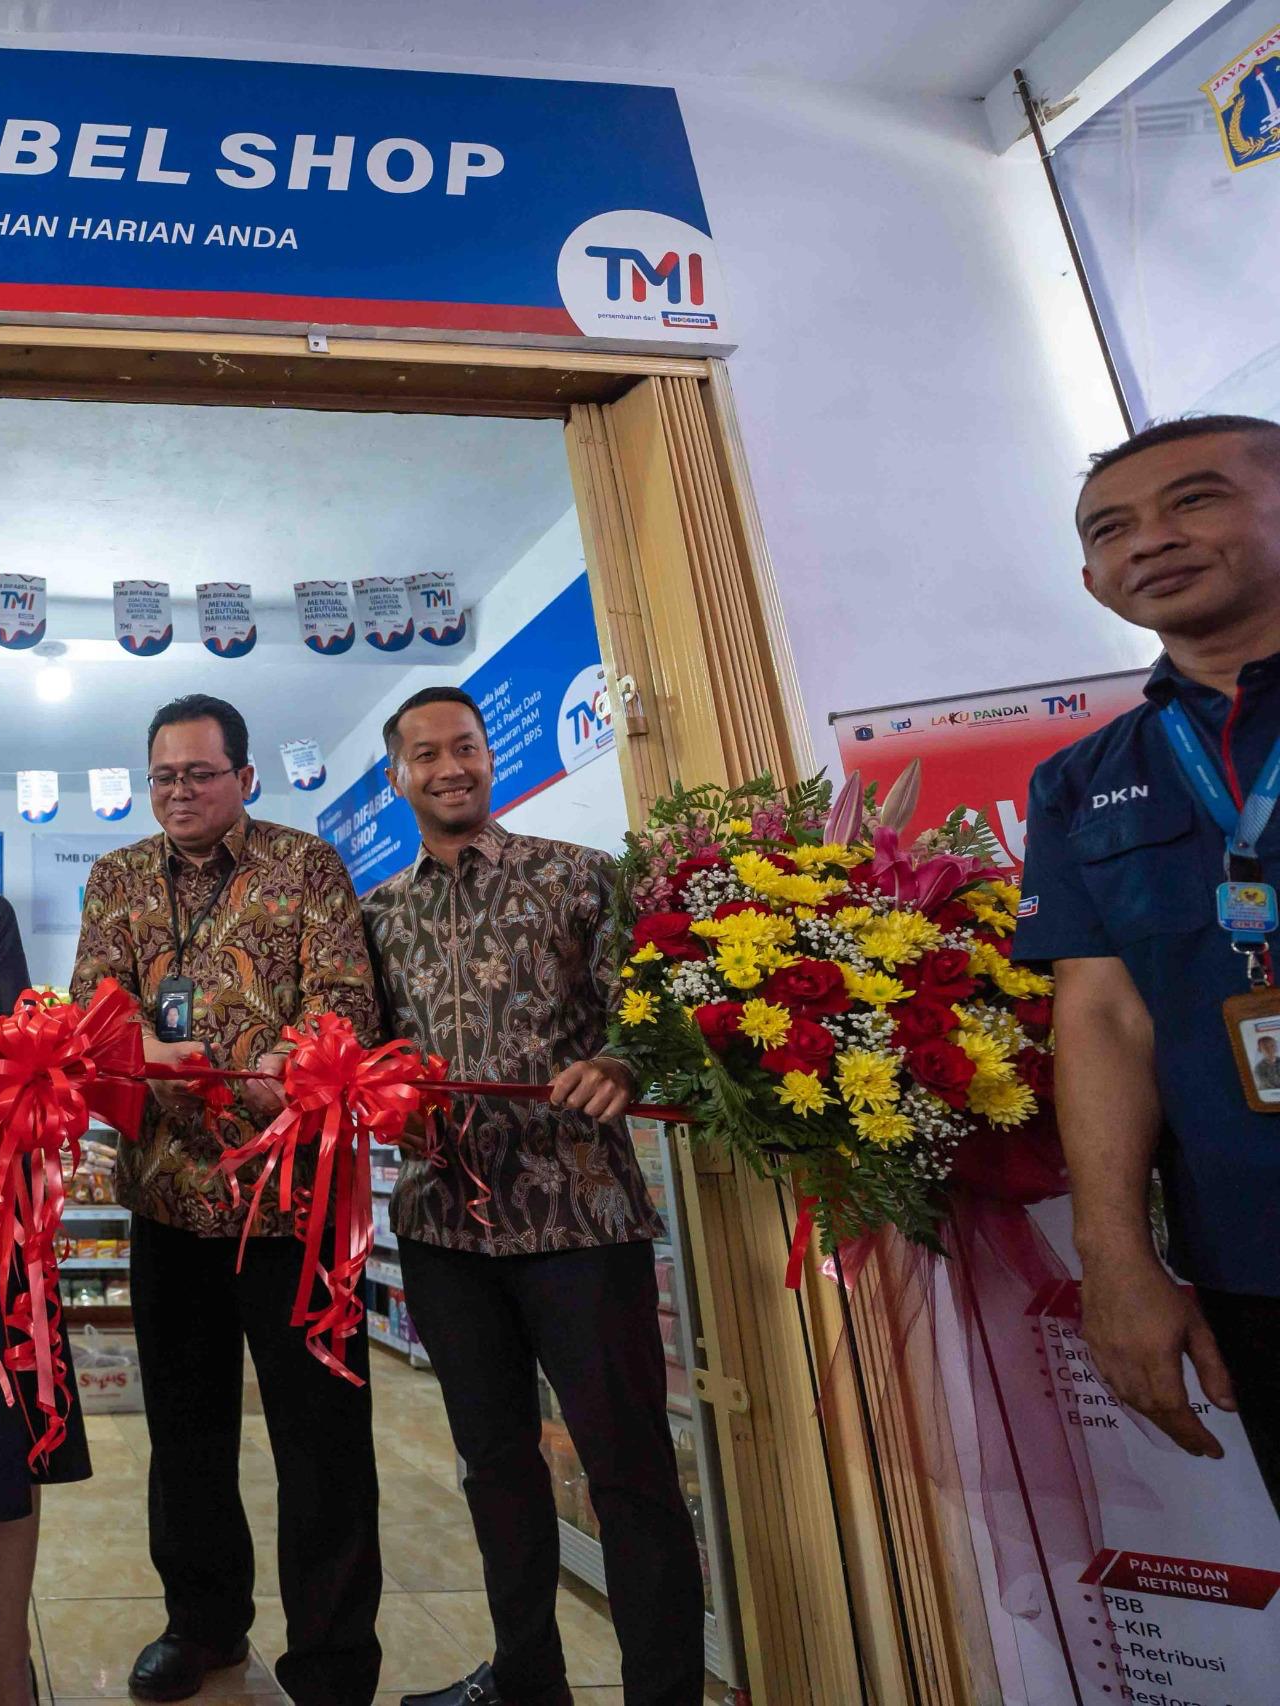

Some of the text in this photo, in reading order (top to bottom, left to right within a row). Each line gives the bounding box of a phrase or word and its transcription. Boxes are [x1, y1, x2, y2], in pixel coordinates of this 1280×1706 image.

[1213, 29, 1280, 92] JAYA RAY
[214, 130, 506, 197] SHOP
[67, 216, 197, 245] HARIAN
[203, 224, 300, 251] ANDA
[584, 245, 705, 306] TMI
[597, 312, 642, 321] persembahan
[0, 591, 35, 611] TMI
[208, 600, 245, 608] MENJUAL
[305, 605, 348, 613] KEBUTUHAN
[420, 588, 452, 608] TMI
[204, 607, 250, 615] KEBUTUHAN
[494, 680, 509, 701] juga
[496, 694, 511, 713] PLN
[496, 718, 503, 730] &
[503, 703, 523, 725] Paket
[522, 690, 542, 711] Data
[1040, 692, 1087, 716] TMI
[521, 708, 540, 731] PAM
[930, 710, 970, 727] LAKU
[973, 704, 1028, 721] PANDAI
[523, 723, 543, 747] BPJS
[498, 759, 523, 782] lainnya
[1091, 784, 1149, 809] DKN
[332, 817, 353, 846] TMB
[353, 784, 395, 831] DIFABEL
[350, 821, 378, 856] SHOP
[55, 852, 81, 863] TMB
[1051, 1344, 1090, 1361] Tari
[1056, 1367, 1096, 1383] Cek
[1060, 1388, 1124, 1407] Trans
[1067, 1411, 1120, 1429] Bank
[1128, 1558, 1229, 1582] PAJAK DAN
[1137, 1576, 1229, 1599] RETRIBUSI
[1103, 1594, 1145, 1614] PBB
[1105, 1619, 1163, 1639] e-KIR
[1110, 1642, 1227, 1673] e-Retribusi
[1114, 1661, 1174, 1686] Hotel
